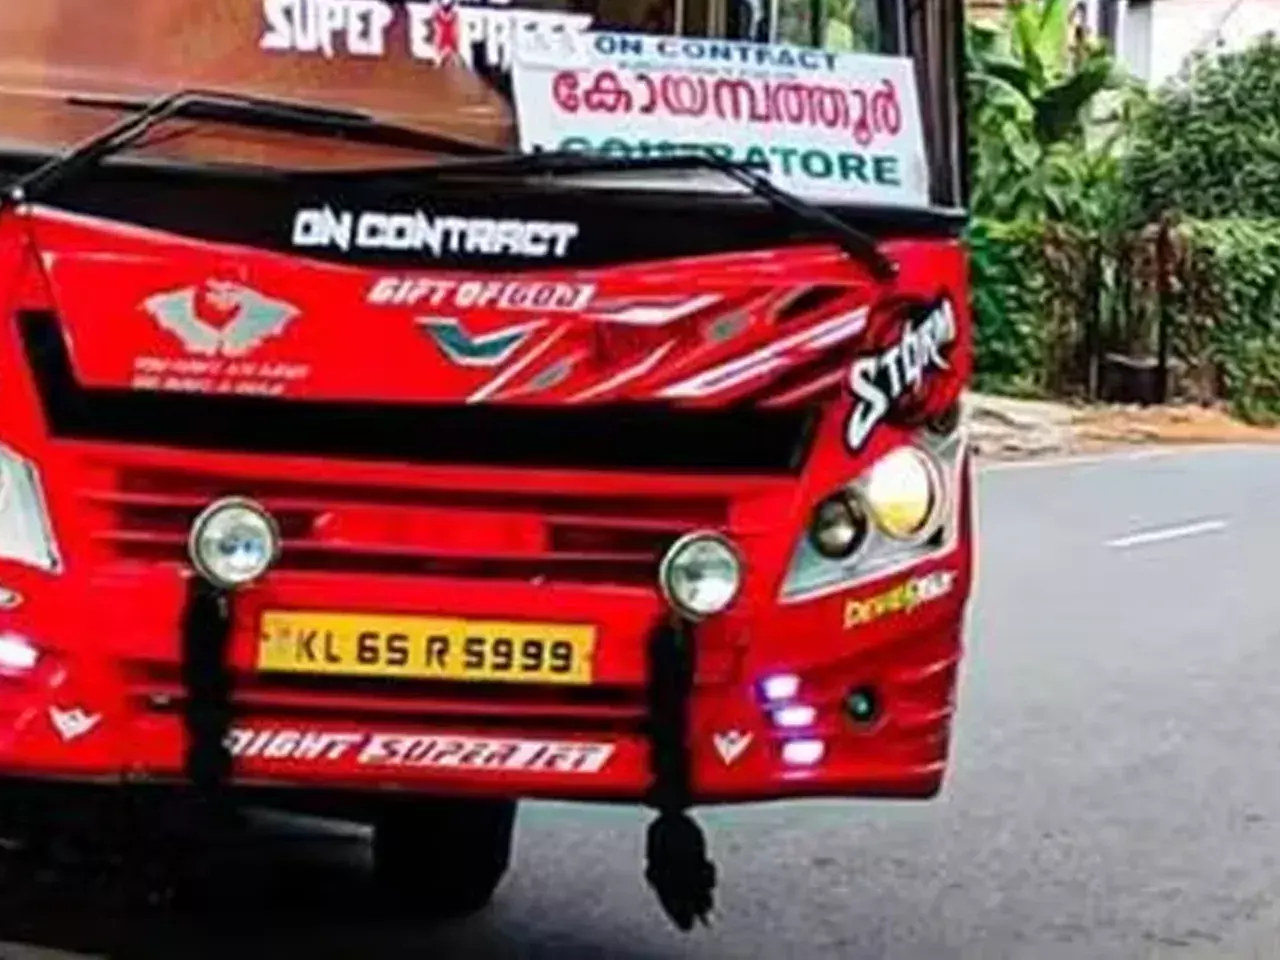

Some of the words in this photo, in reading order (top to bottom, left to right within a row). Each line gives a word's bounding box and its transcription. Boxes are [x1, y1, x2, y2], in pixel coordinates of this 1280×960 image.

[594, 34, 642, 57] ON
[657, 36, 841, 72] CONTRACT
[560, 136, 902, 186] BATORE
[292, 205, 353, 252] ON
[355, 208, 579, 258] CONTRACT
[367, 276, 455, 306] GIFT
[295, 628, 342, 663] KL
[356, 631, 409, 666] 65
[425, 634, 450, 668] R
[463, 637, 573, 674] 5999
[380, 737, 520, 766] SUPER
[525, 742, 604, 770] JET
